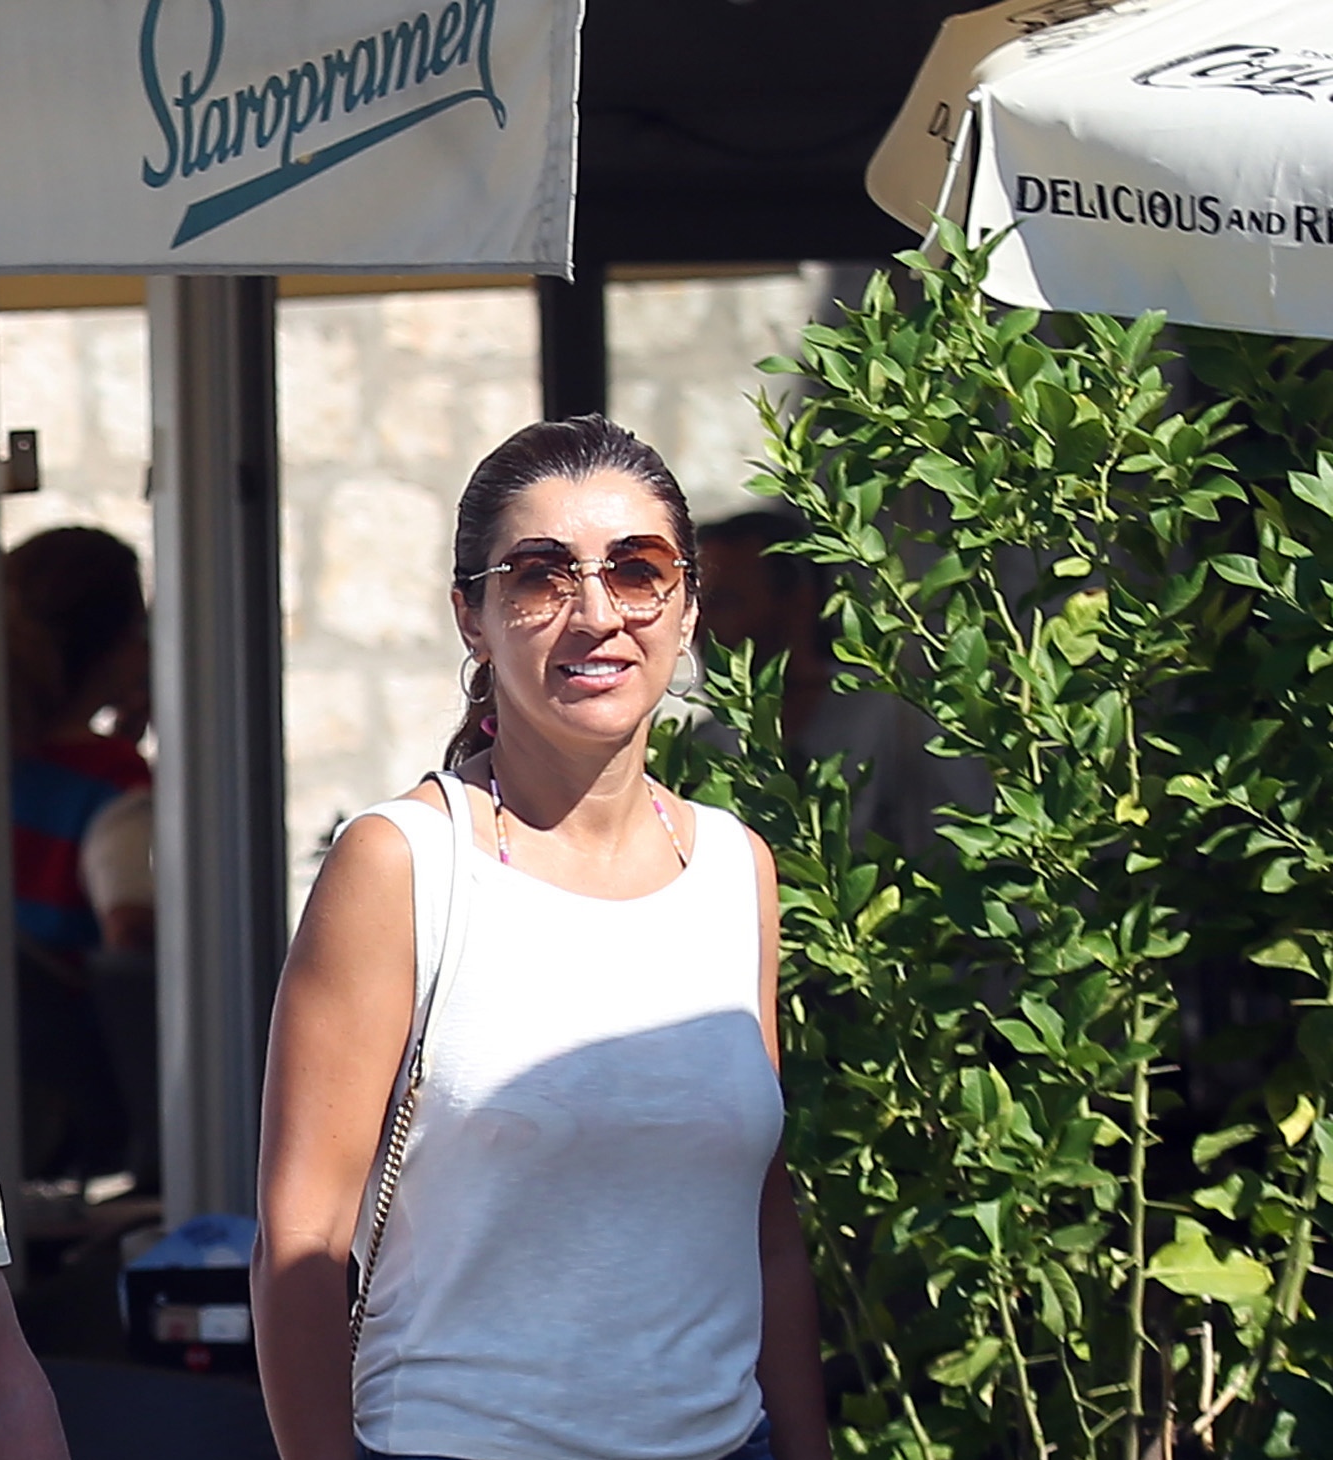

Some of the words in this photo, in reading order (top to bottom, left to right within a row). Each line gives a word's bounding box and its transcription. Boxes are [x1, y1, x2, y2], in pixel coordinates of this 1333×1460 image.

[142, 0, 506, 188] Staropramen
[1015, 174, 1221, 235] DELICIOUS
[1225, 208, 1287, 236] AND
[1294, 204, 1333, 244] R
